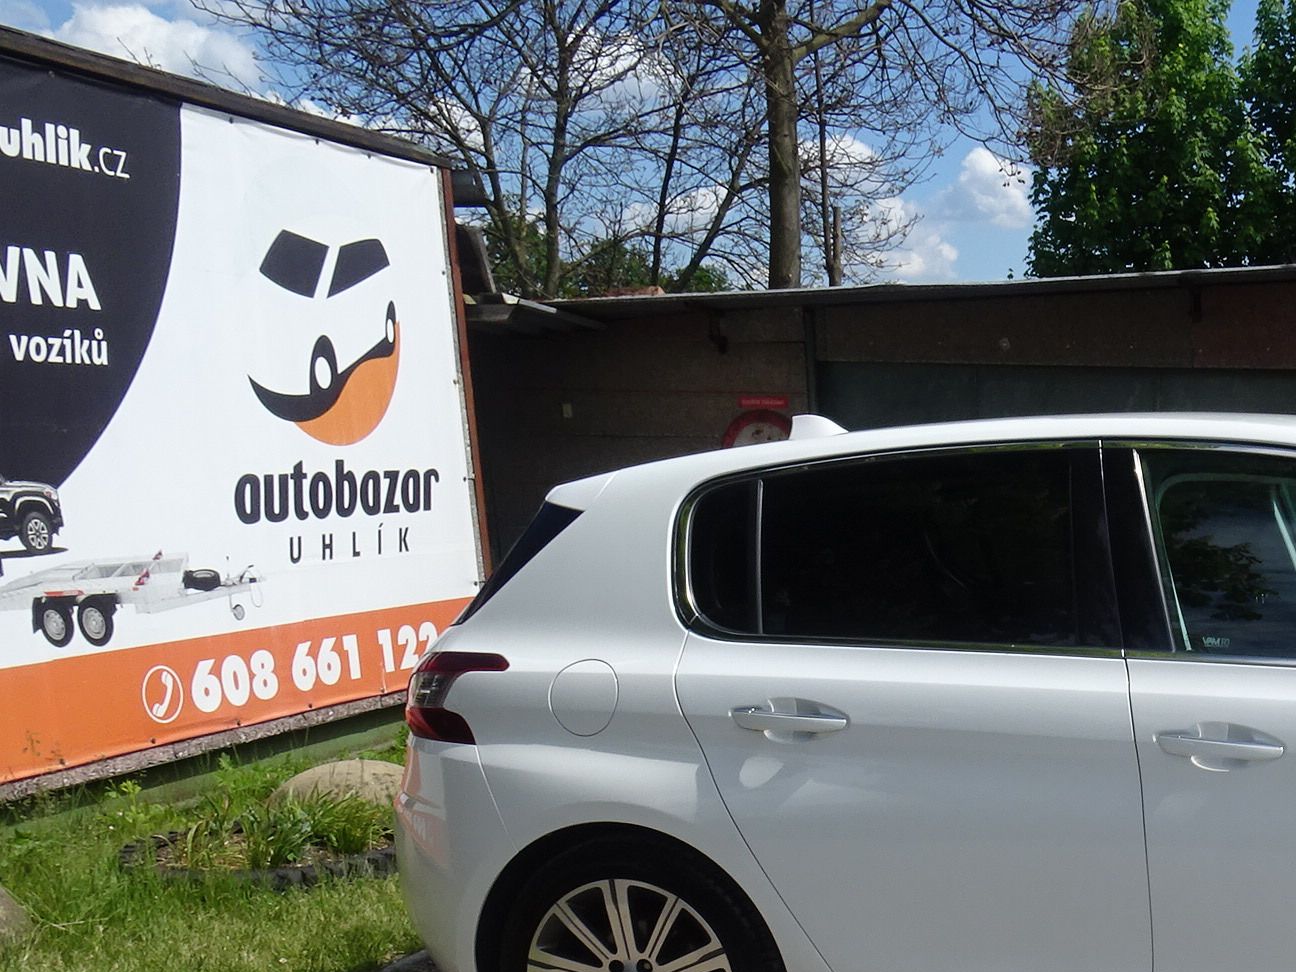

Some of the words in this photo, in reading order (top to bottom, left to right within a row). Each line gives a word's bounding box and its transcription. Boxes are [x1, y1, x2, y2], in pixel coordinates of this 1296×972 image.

[9, 328, 109, 366] vozíků
[234, 459, 440, 525] autobazar
[289, 523, 409, 564] UHLÍK
[191, 650, 279, 713] 608
[292, 634, 361, 692] 661
